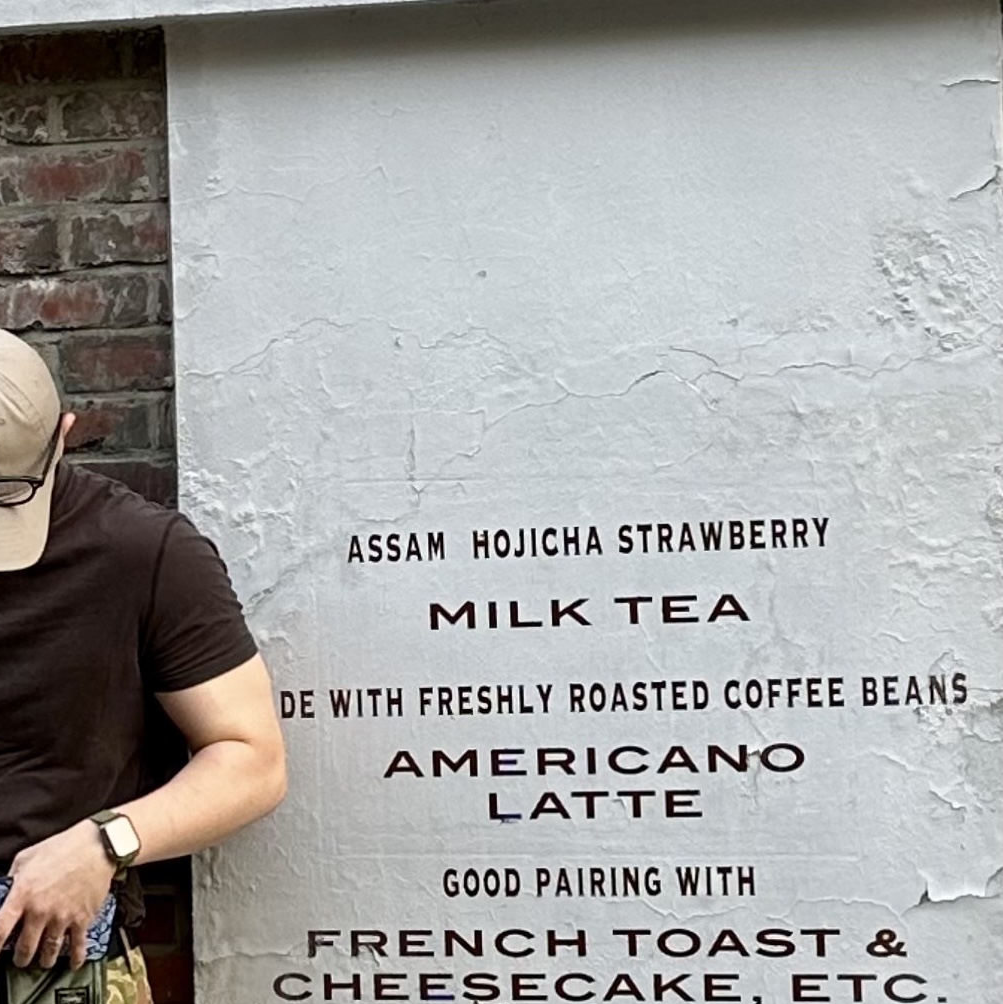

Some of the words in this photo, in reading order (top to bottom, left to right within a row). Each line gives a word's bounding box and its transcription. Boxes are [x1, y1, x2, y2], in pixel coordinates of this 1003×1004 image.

[347, 531, 446, 564] ASSAM
[471, 525, 603, 560] HOJICHA
[617, 517, 830, 556] STRAWBERRY
[428, 598, 592, 631] MILK
[613, 594, 751, 626] TEA
[280, 690, 315, 719] DE
[329, 687, 404, 718] WITH
[418, 684, 553, 717] FRESHLY
[569, 680, 710, 714] ROASTED
[723, 676, 846, 711] COFFEE
[861, 672, 969, 707] BEANS
[382, 742, 806, 779] AMERICANO
[488, 789, 703, 821] LATTE
[442, 867, 522, 899] GOOD
[535, 865, 663, 899] PAIRING
[674, 866, 756, 897] WITH
[307, 929, 587, 958] FRENCH
[612, 928, 841, 958] TOAST
[866, 928, 908, 958] &
[791, 973, 948, 1004] ETC.
